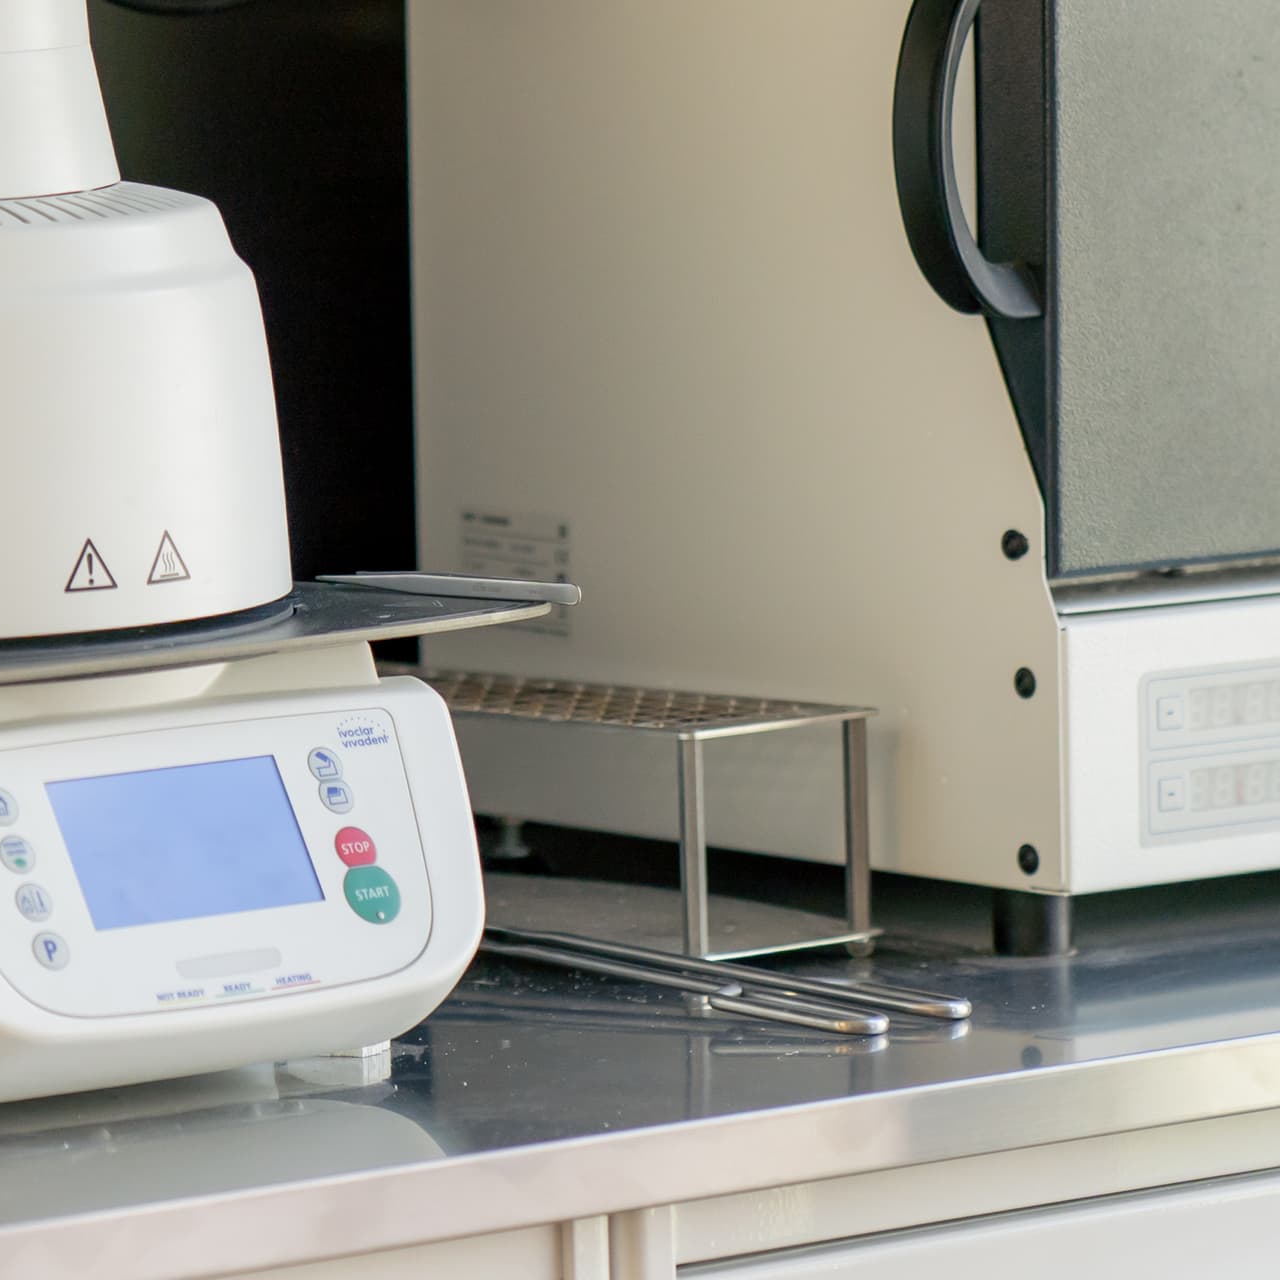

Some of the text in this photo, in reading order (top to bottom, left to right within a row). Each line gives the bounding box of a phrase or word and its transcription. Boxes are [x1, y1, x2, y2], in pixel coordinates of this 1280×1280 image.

[337, 725, 373, 738] ivoclar
[342, 734, 388, 748] vivadent
[341, 840, 370, 855] STOP
[355, 886, 389, 901] START
[43, 939, 57, 962] P
[275, 973, 313, 984] HEATING
[223, 982, 251, 992] READY
